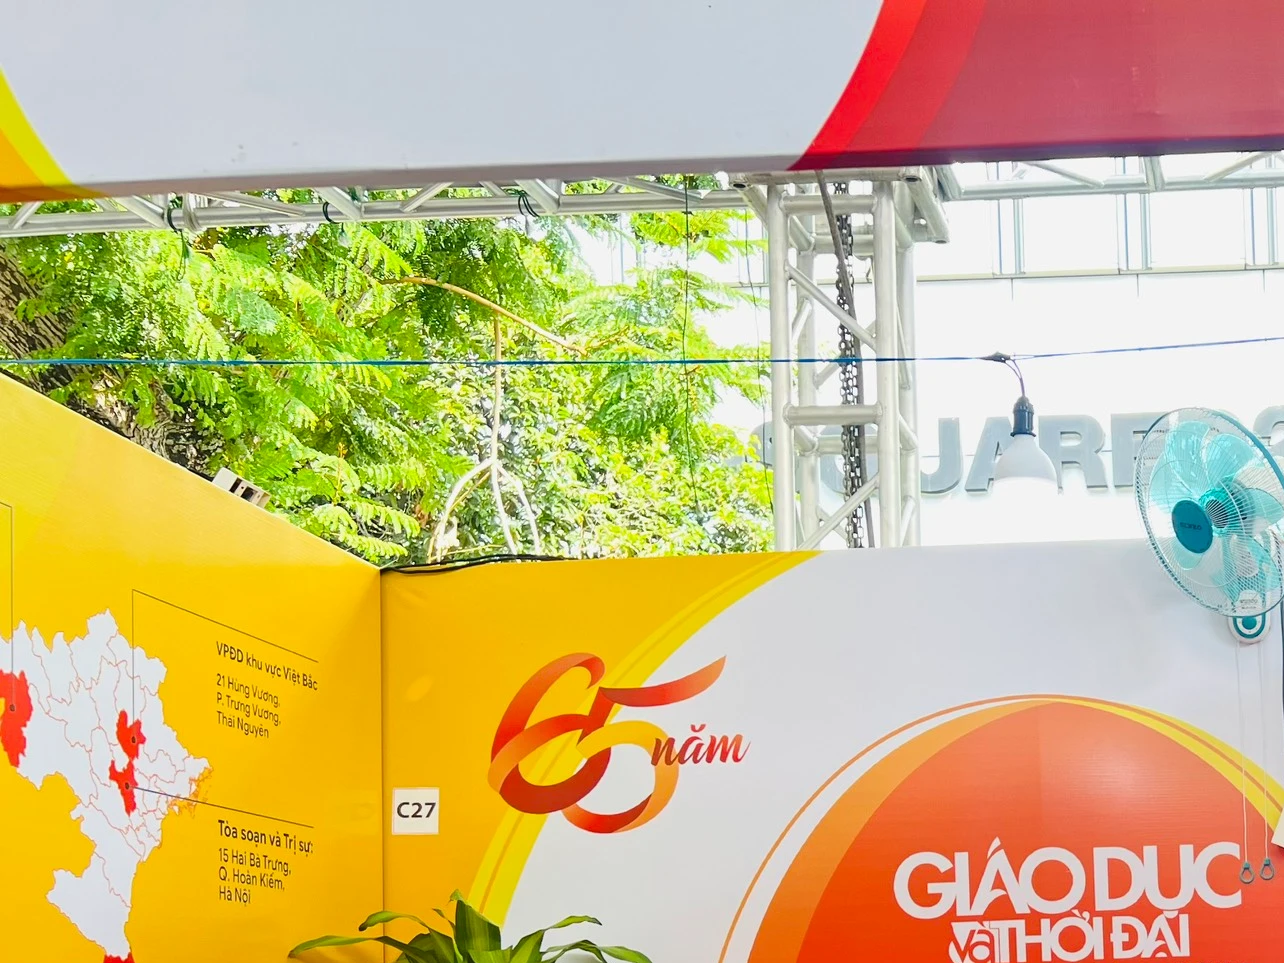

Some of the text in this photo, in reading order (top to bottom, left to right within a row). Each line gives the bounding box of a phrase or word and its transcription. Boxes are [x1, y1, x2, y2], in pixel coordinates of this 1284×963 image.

[216, 641, 318, 690] VPĐD khu vực Việt Bắc
[651, 723, 752, 766] năm
[396, 801, 436, 819] C27
[218, 820, 313, 857] Tòa soạn và Trị sự:
[219, 848, 291, 876] 15 Hai Bà Trưng,
[893, 836, 1086, 919] GIÁO
[219, 866, 285, 891] Q. Hoàn Kiếm,
[219, 885, 250, 907] Hà Nội
